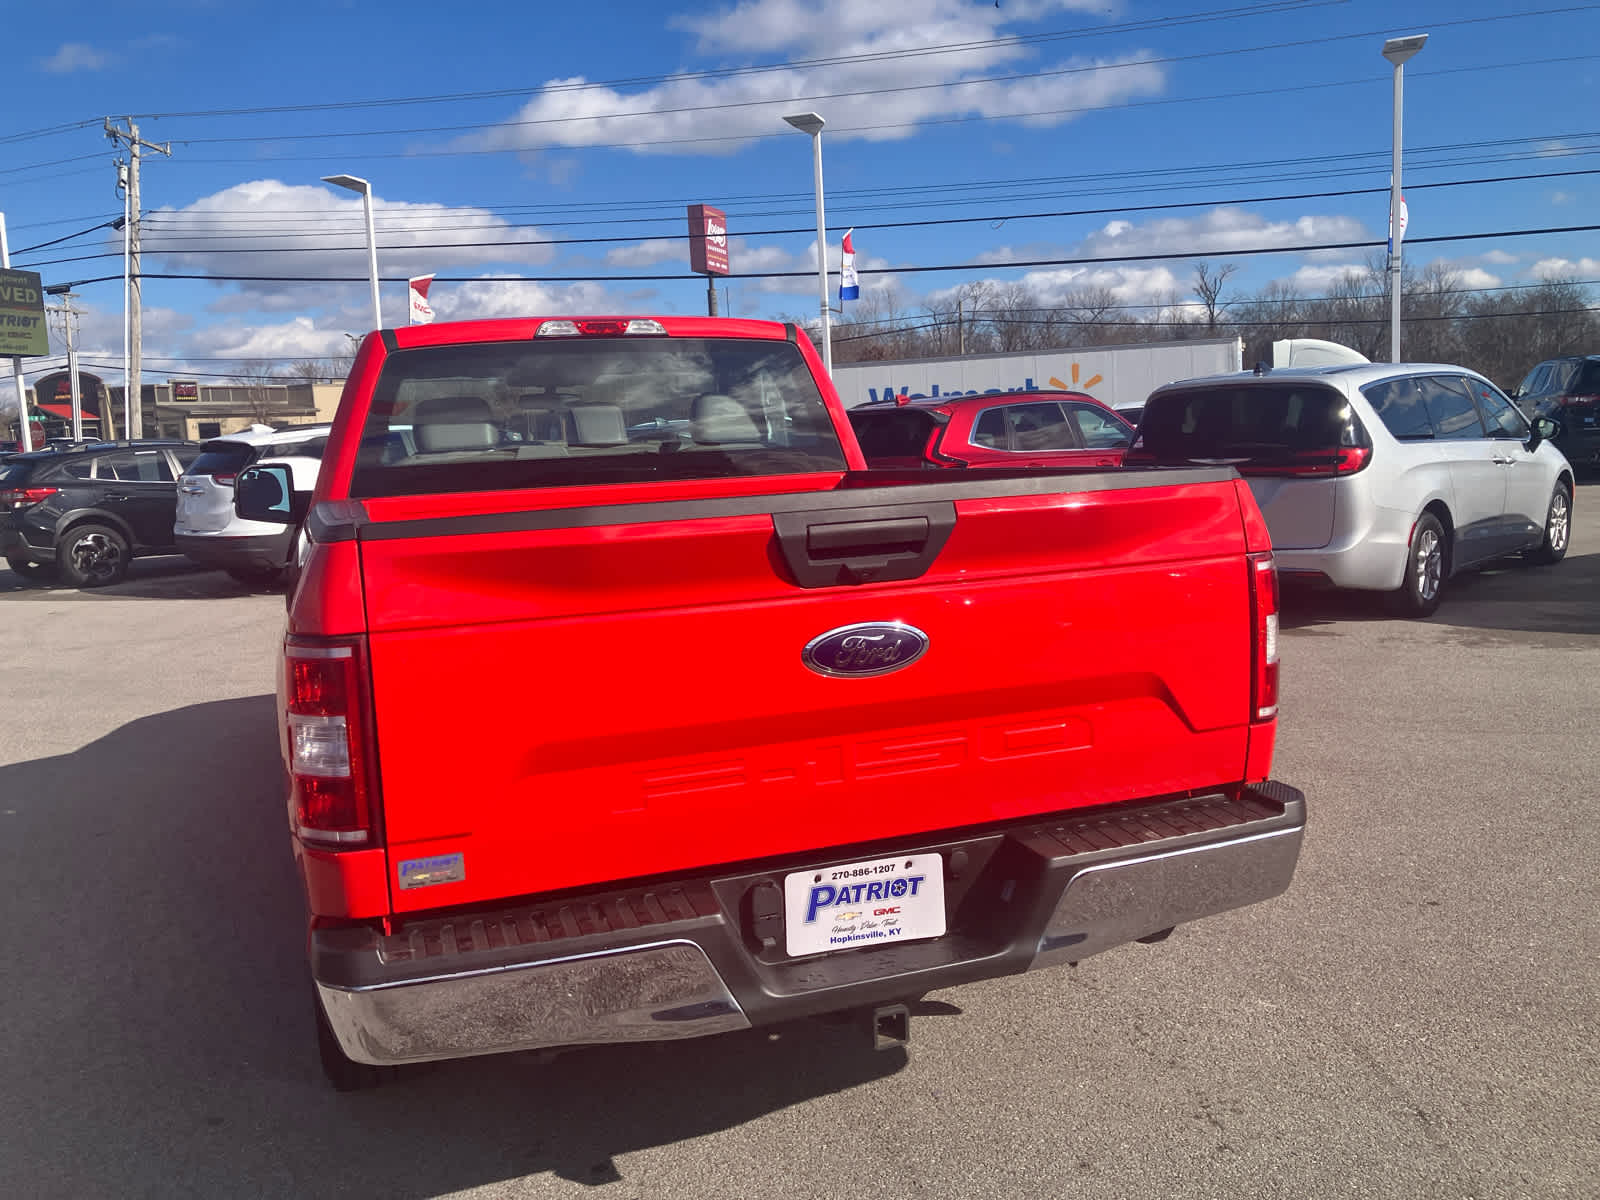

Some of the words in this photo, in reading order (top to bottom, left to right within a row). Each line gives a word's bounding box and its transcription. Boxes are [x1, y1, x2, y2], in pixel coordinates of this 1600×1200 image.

[834, 634, 902, 666] Ford
[832, 864, 896, 880] 270-886-1207
[804, 876, 924, 923] PATRIOT
[873, 906, 901, 917] GMC
[830, 931, 887, 944] Hopkinsville,
[888, 927, 902, 937] KY
